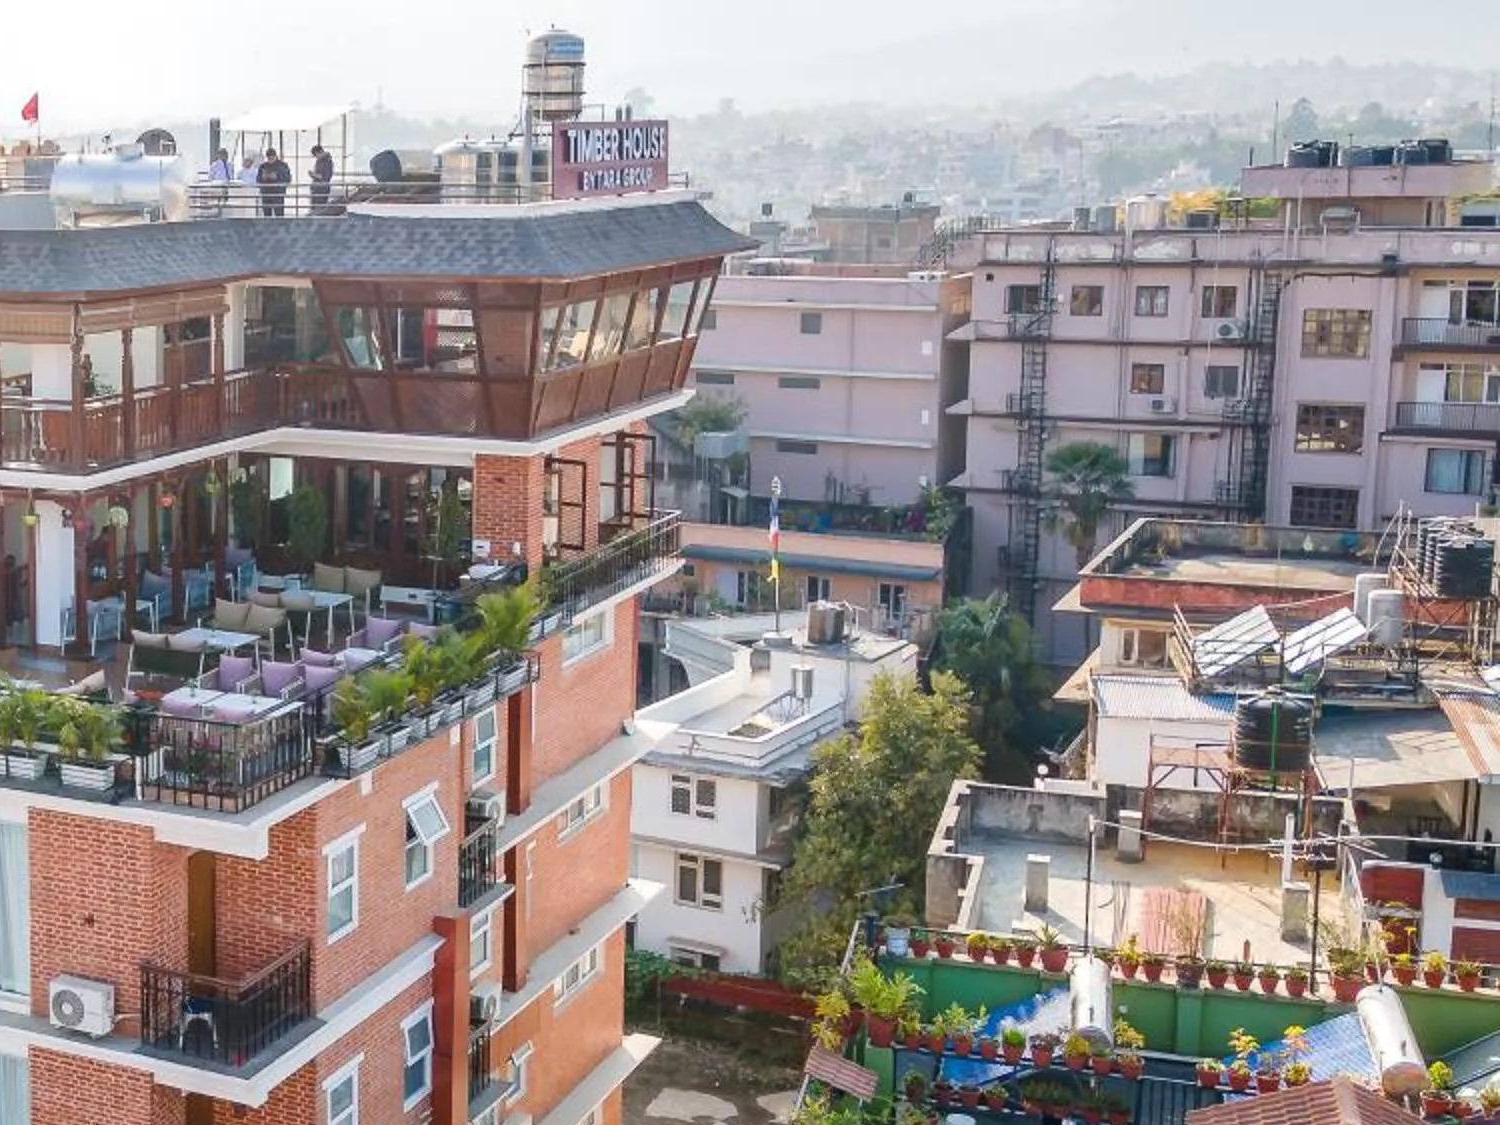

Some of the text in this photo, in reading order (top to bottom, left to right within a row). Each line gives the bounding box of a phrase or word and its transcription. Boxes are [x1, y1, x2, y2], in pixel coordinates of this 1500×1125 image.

[567, 126, 666, 164] TIMBER HOUSE
[583, 170, 596, 191] BY
[623, 166, 654, 187] GROUP
